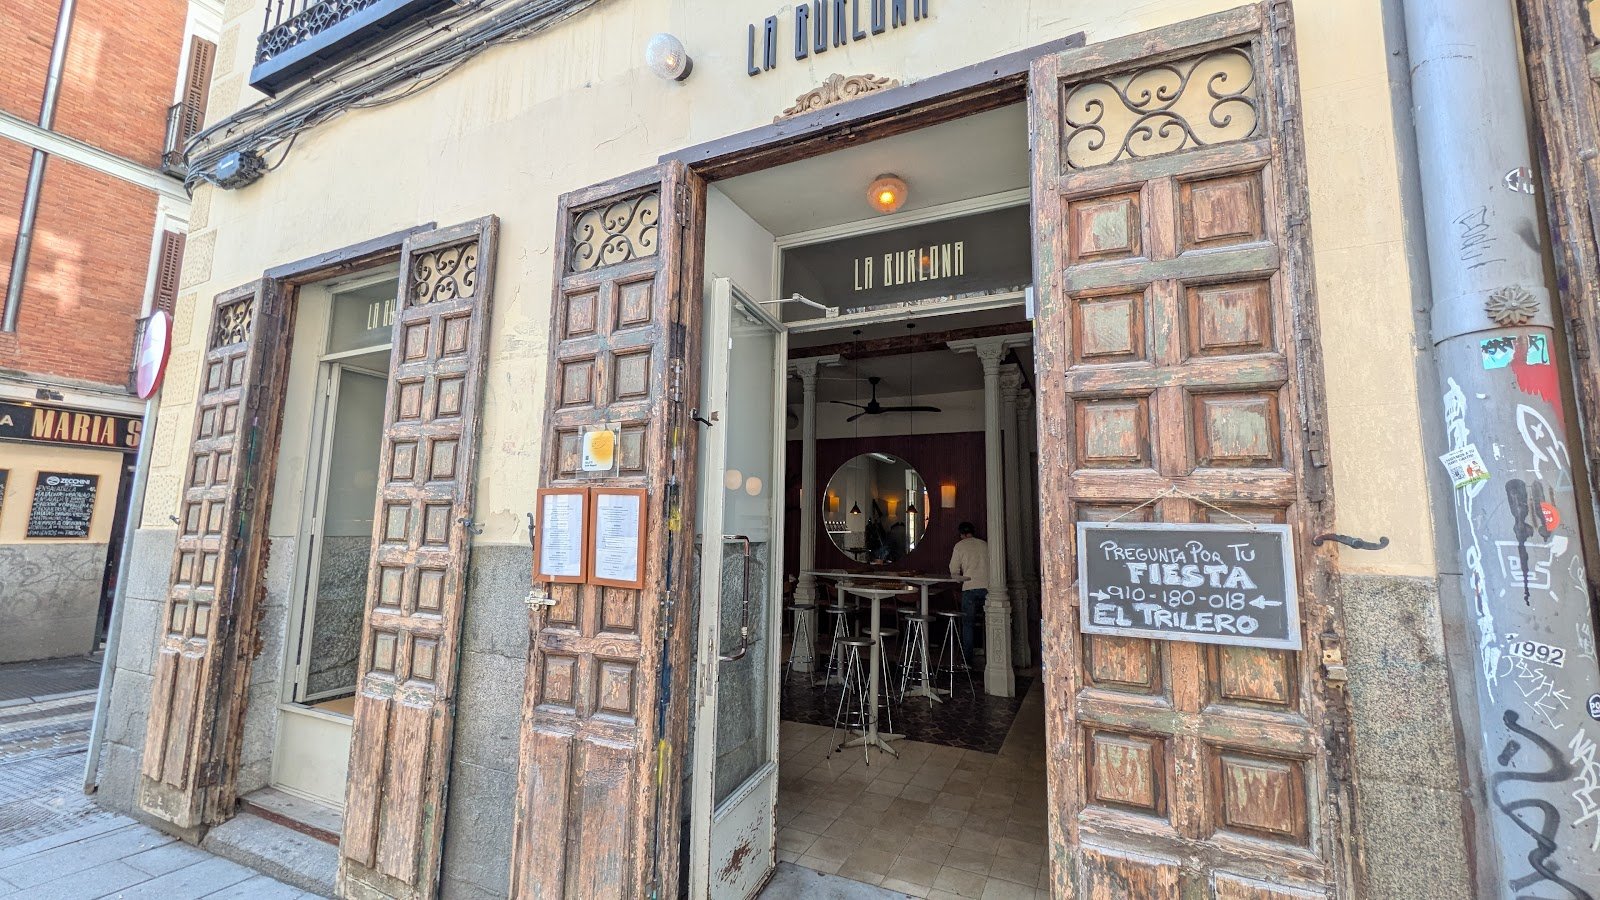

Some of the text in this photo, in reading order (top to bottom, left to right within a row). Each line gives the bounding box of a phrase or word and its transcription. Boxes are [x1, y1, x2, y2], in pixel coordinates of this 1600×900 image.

[748, 15, 777, 77] LA
[854, 241, 964, 291] LA BURLONA
[367, 302, 380, 331] LA
[31, 408, 117, 446] MARIA
[1100, 540, 1256, 565] PREGUNTA POR TU
[1126, 562, 1258, 590] FIESTA
[1093, 602, 1259, 635] EL TRILERO
[1514, 641, 1565, 667] 1992
